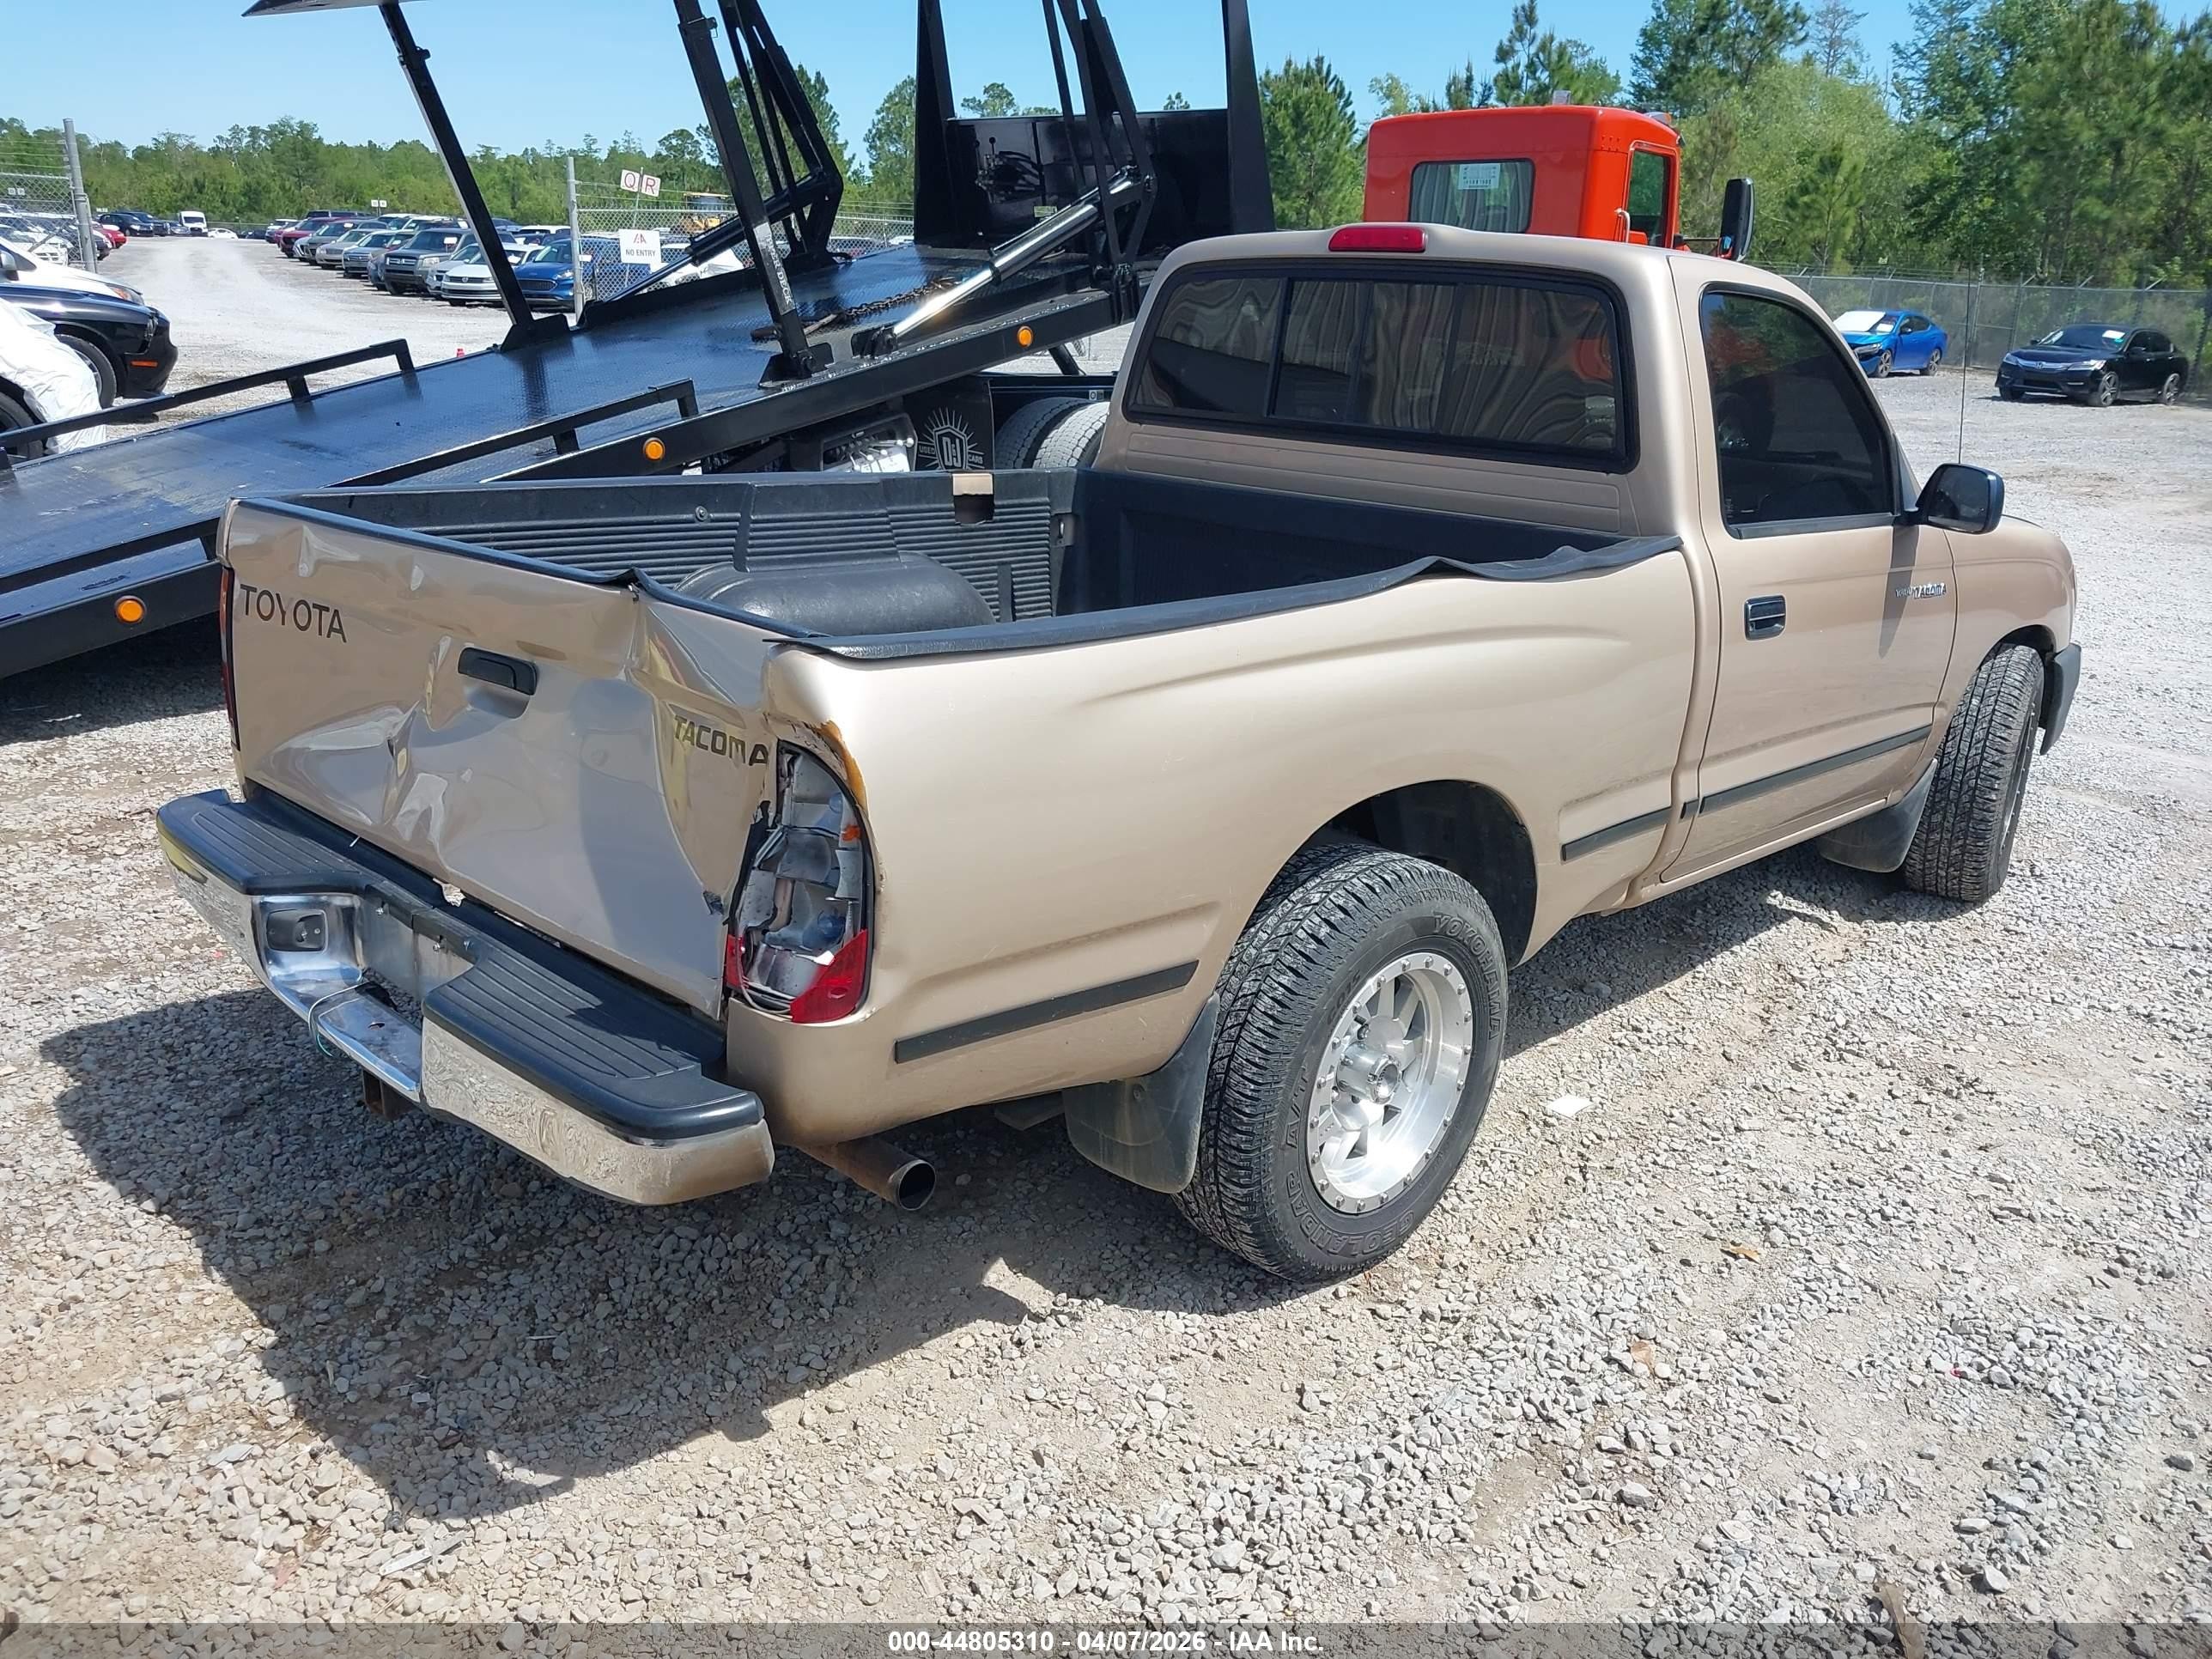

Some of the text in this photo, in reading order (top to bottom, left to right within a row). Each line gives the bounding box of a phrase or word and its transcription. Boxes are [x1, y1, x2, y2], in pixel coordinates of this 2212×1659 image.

[624, 173, 636, 190] Q
[645, 177, 656, 194] R
[776, 270, 793, 306] DECK
[240, 583, 347, 643] TOYOTA
[674, 714, 769, 767] TACOMA
[1433, 915, 1501, 1041] YOKOHAMA
[1285, 1170, 1415, 1257] GEOLANDAR
